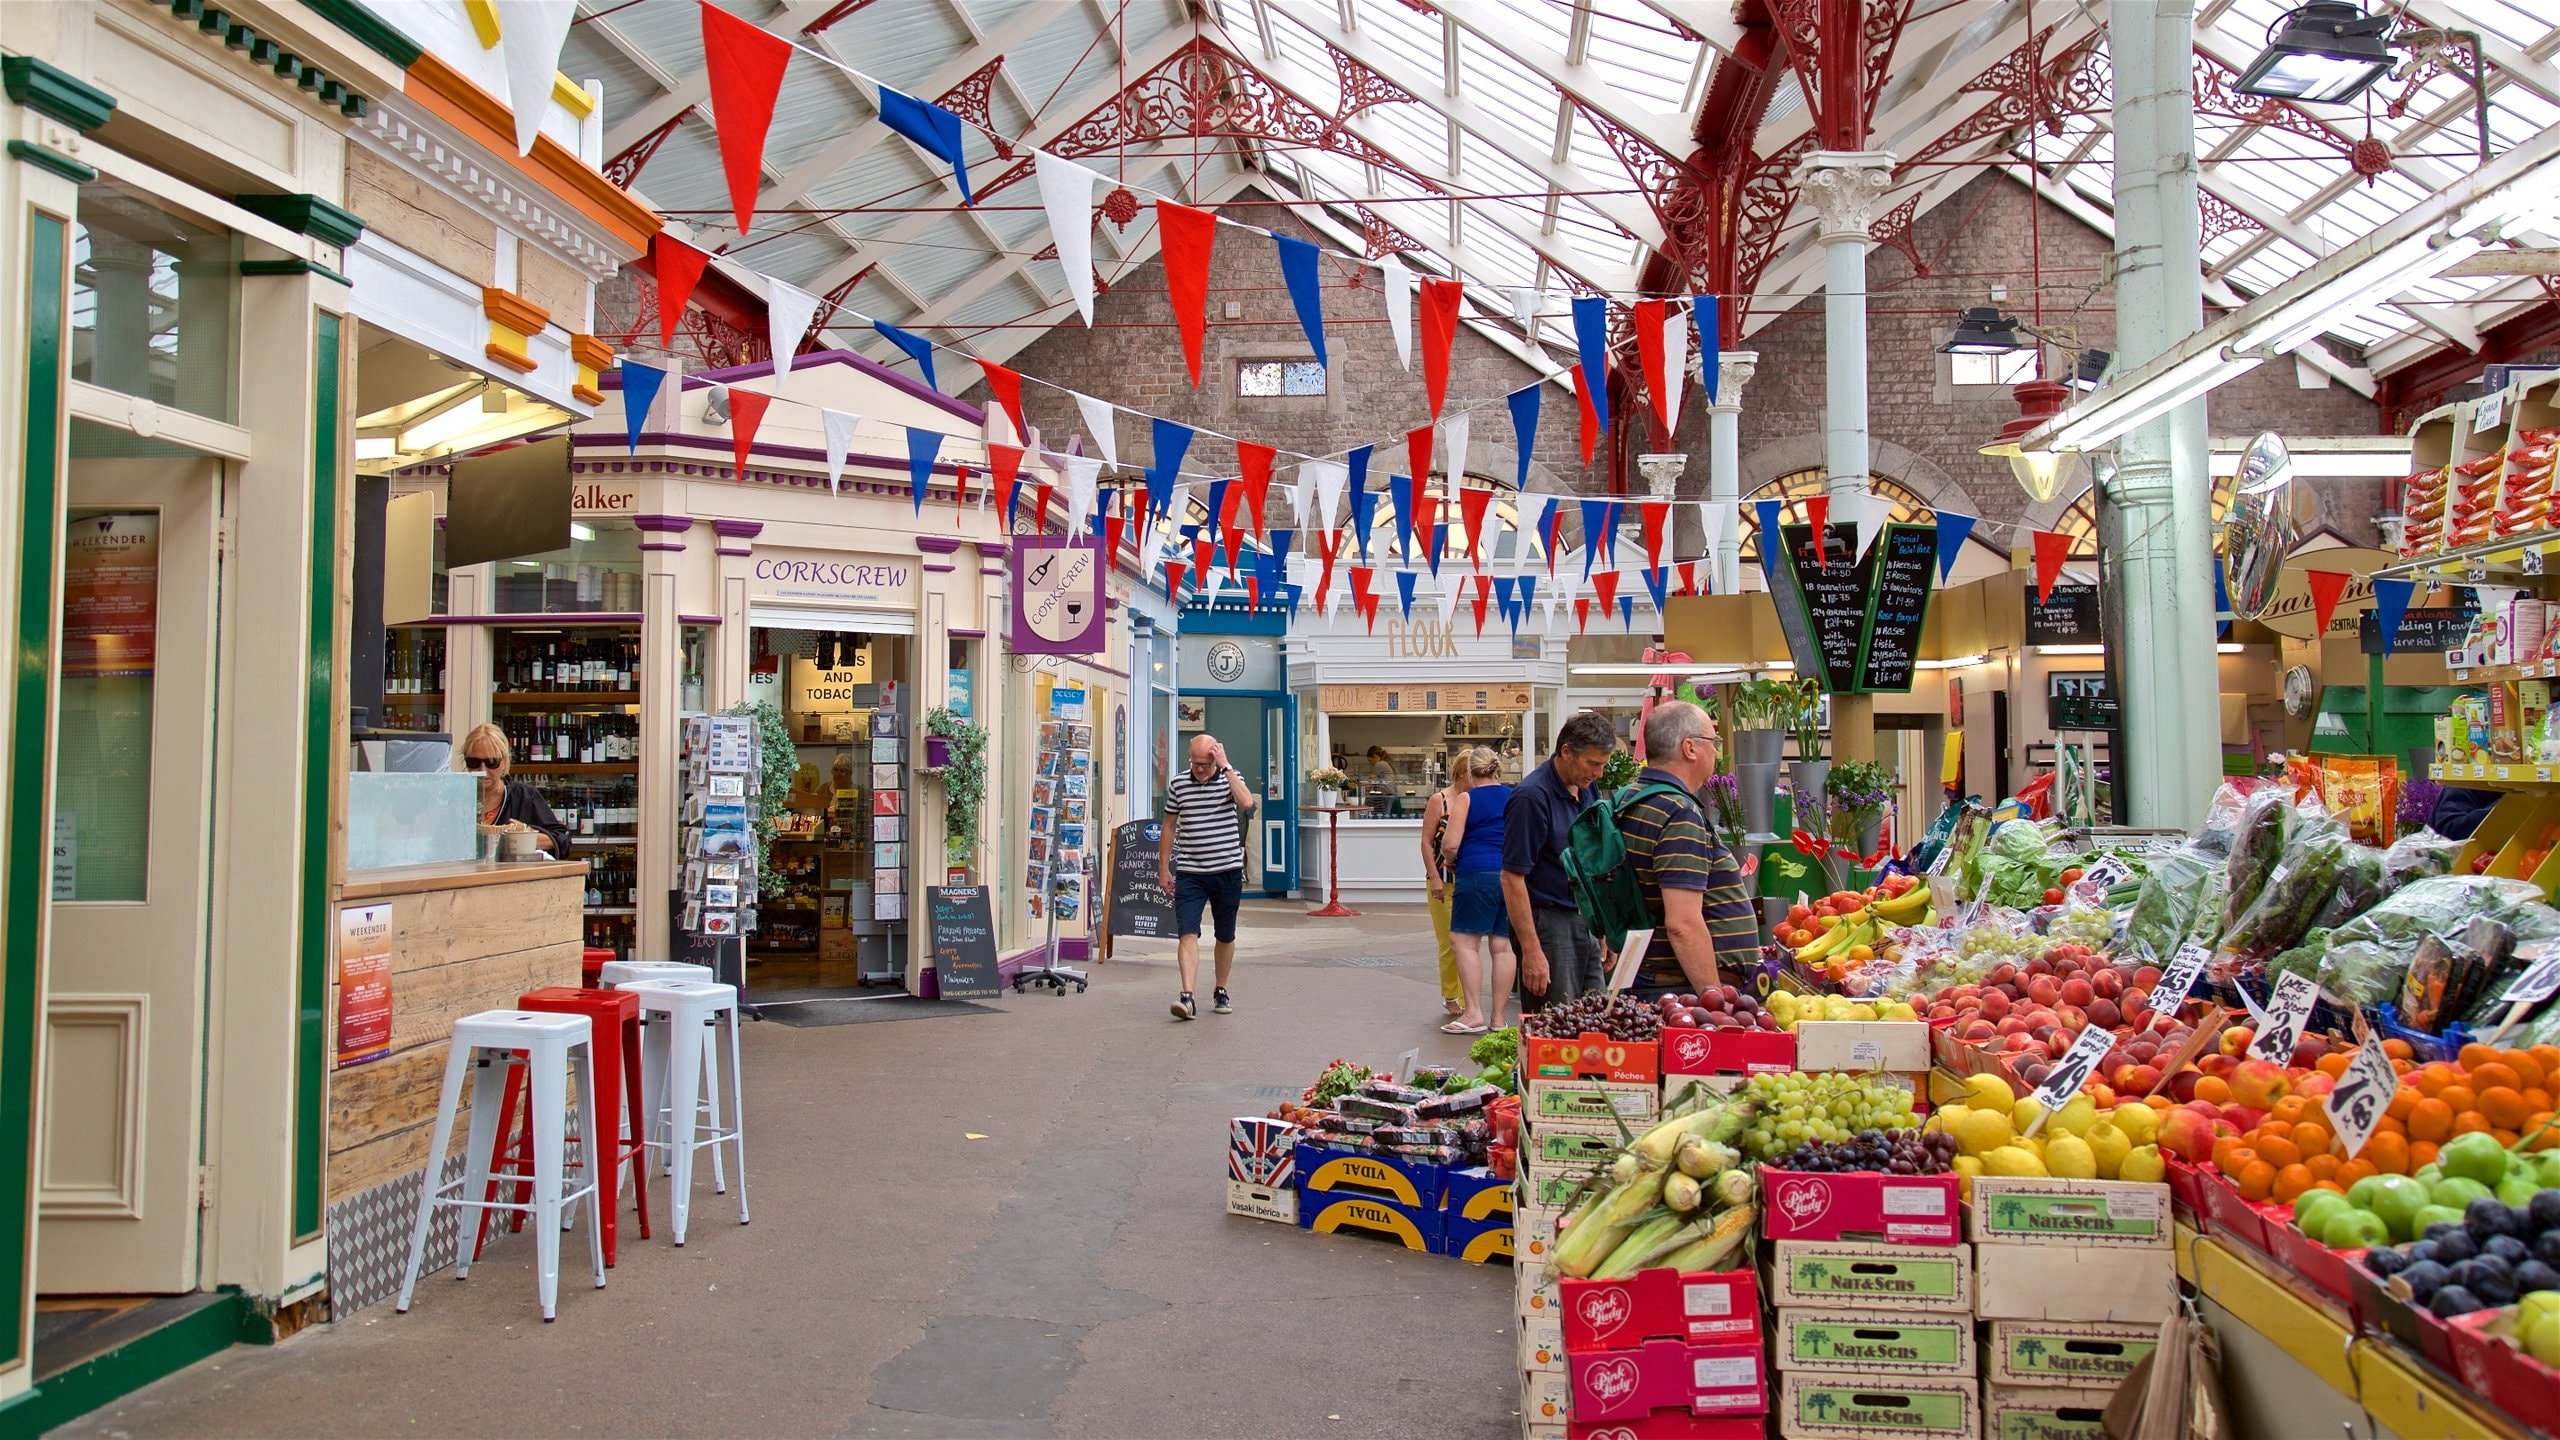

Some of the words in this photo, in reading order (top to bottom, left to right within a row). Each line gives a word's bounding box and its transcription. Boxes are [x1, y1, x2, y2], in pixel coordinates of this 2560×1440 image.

[73, 535, 146, 547] WEEKENDER
[1893, 534, 1920, 546] Special
[756, 559, 907, 587] CORKSCREW
[1885, 571, 1892, 580] 5
[1032, 553, 1089, 625] CORKSCREW
[1805, 583, 1815, 591] 18
[1812, 607, 1825, 617] 24
[1387, 618, 1458, 659] FLOUR
[2393, 635, 2436, 646] uneral
[1833, 648, 1848, 656] and
[1220, 655, 1233, 671] J
[1868, 660, 1879, 669] and
[823, 672, 853, 683] AND
[1055, 690, 1082, 698] JERSEY
[1324, 687, 1364, 707] FLOUR
[1121, 823, 1137, 836] NEW
[1125, 834, 1136, 844] IN
[1119, 861, 1151, 870] GRANDES
[940, 888, 978, 896] MAGNERS
[1119, 893, 1139, 904] WHITE
[1144, 892, 1150, 902] &
[350, 924, 386, 936] WEEKENDER
[2159, 967, 2192, 991] 75
[1679, 1038, 1702, 1054] Pink
[1683, 1048, 1705, 1060] Lady
[1614, 1069, 1646, 1081] Pêches
[2041, 1052, 2089, 1100] 79
[1343, 1163, 1387, 1181] VIDAL
[1784, 1185, 1818, 1208] Pink
[1231, 1200, 1255, 1213] Vasaki
[1255, 1205, 1281, 1218] Ibérica
[1347, 1205, 1392, 1224] VIDAL
[1792, 1199, 1824, 1217] Lady
[1584, 1294, 1618, 1318] Pink
[1594, 1306, 1624, 1327] Lady
[1591, 1365, 1626, 1390] Pink
[1601, 1378, 1631, 1399] Lady
